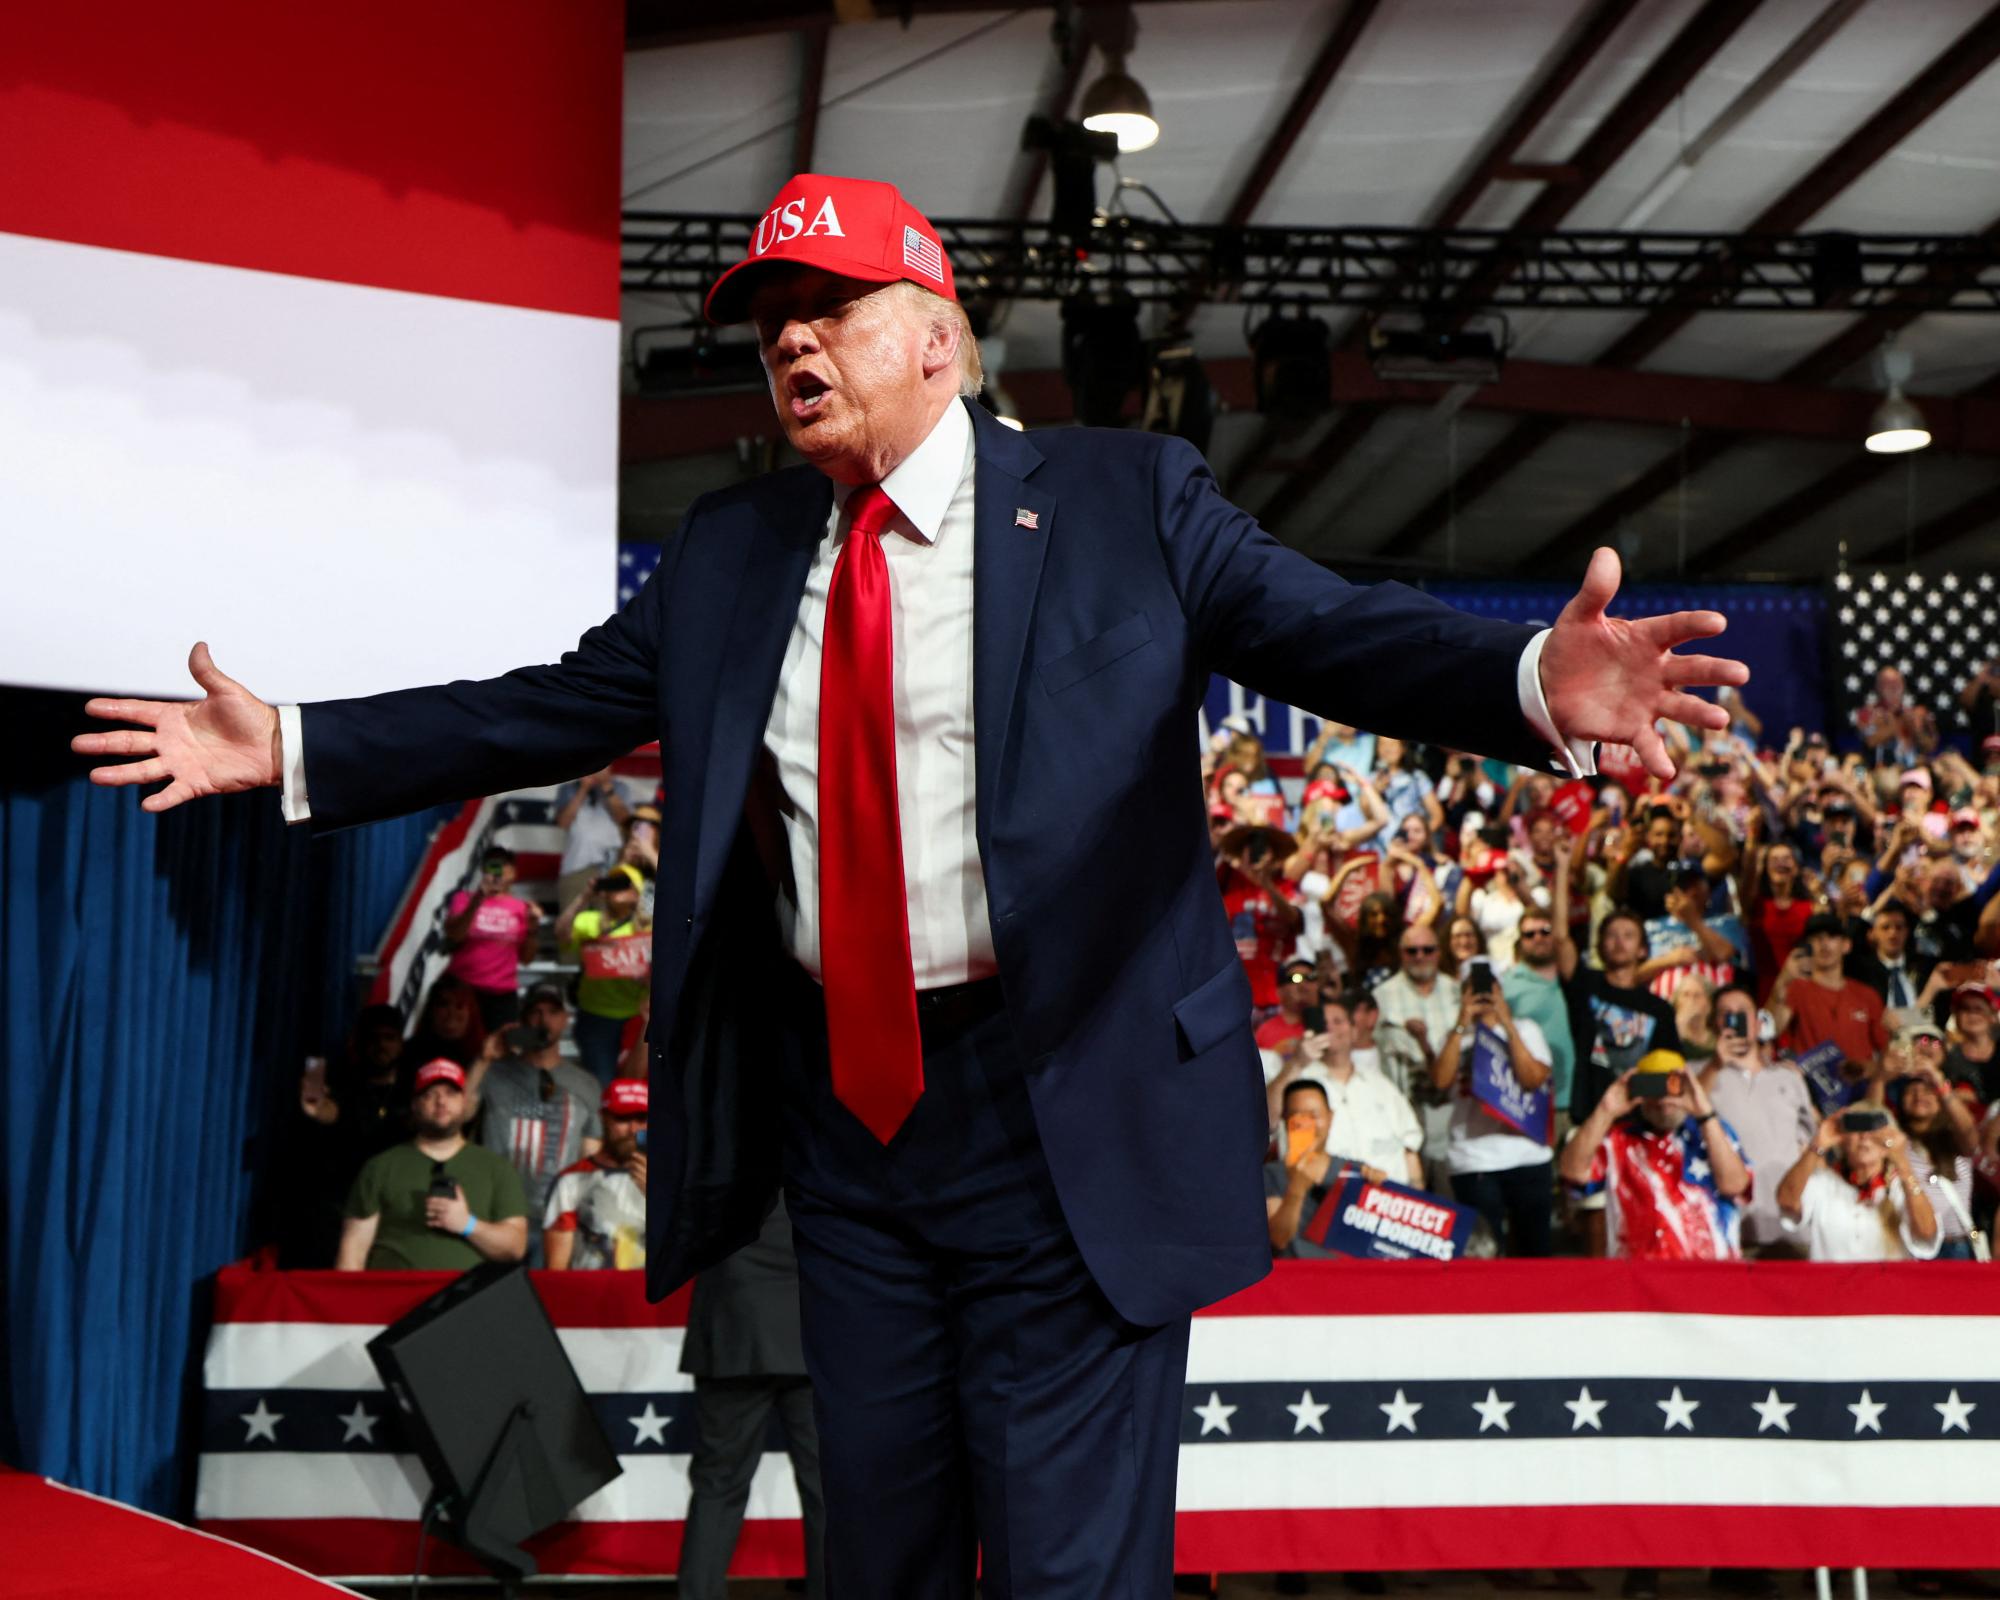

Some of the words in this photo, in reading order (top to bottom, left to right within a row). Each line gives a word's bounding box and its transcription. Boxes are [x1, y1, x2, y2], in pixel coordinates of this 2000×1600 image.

[755, 195, 846, 256] USA
[1343, 1204, 1381, 1234] OUR
[1376, 1218, 1455, 1261] BORDERS
[1364, 1188, 1450, 1234] PROTECT
